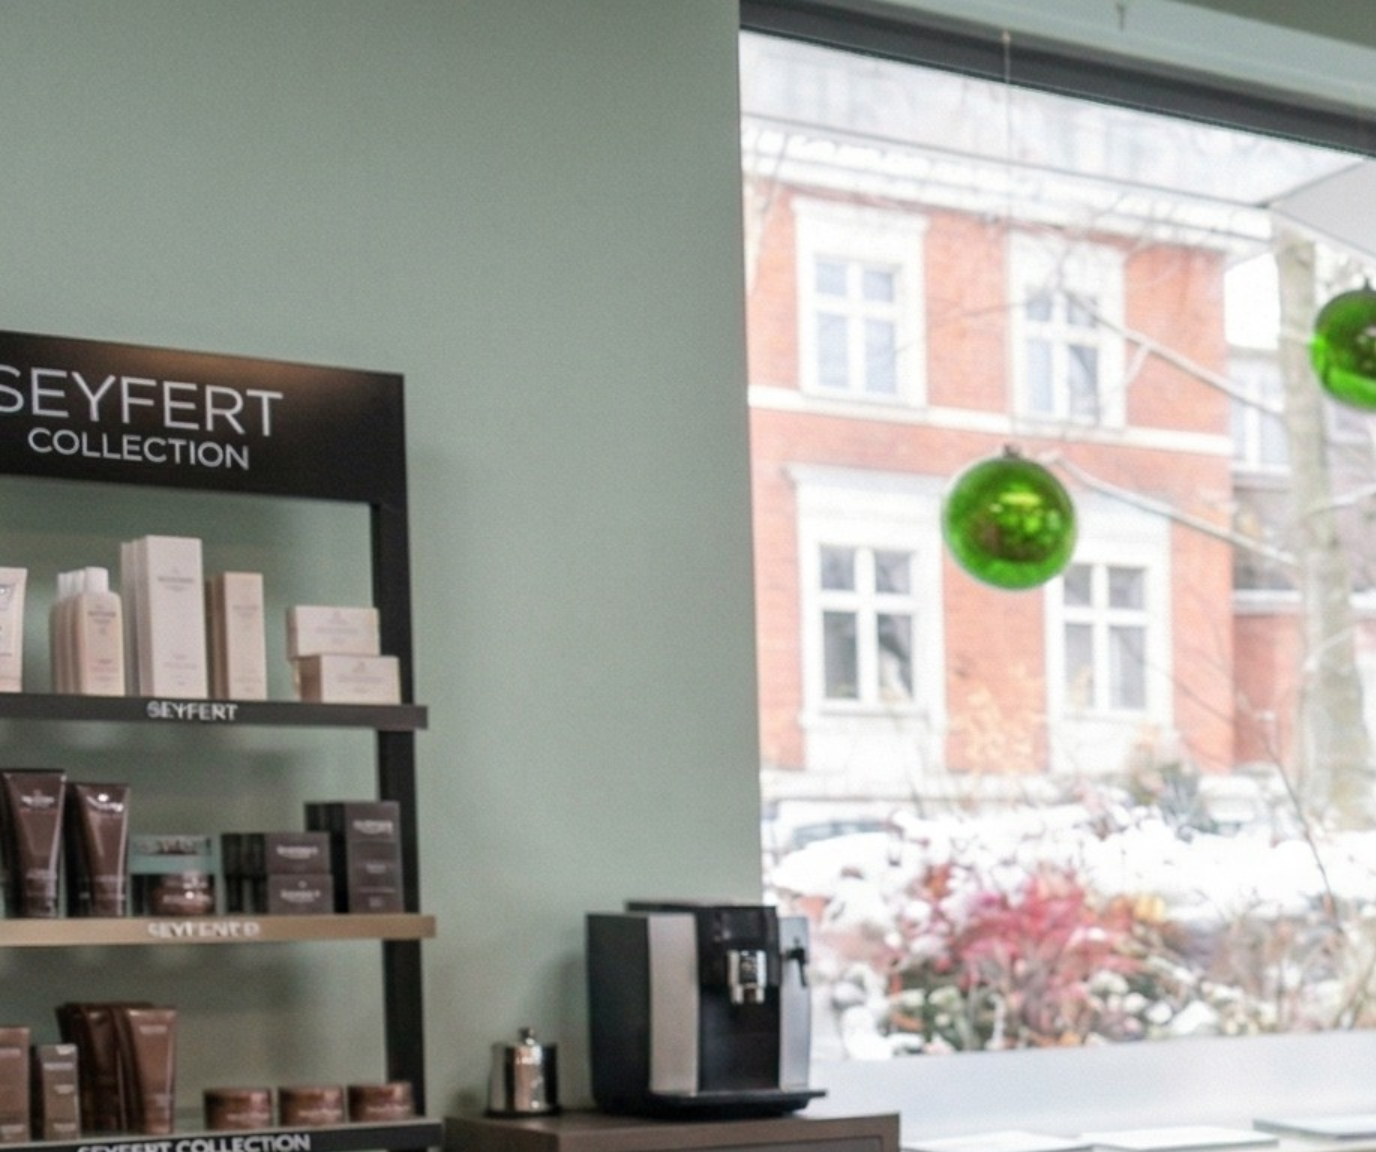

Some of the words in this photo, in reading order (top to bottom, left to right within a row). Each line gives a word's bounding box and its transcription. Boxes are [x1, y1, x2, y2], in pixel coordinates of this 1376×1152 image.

[0, 363, 284, 437] SEYFERT
[27, 426, 249, 470] COLLECTION
[146, 699, 239, 722] SEYFERT
